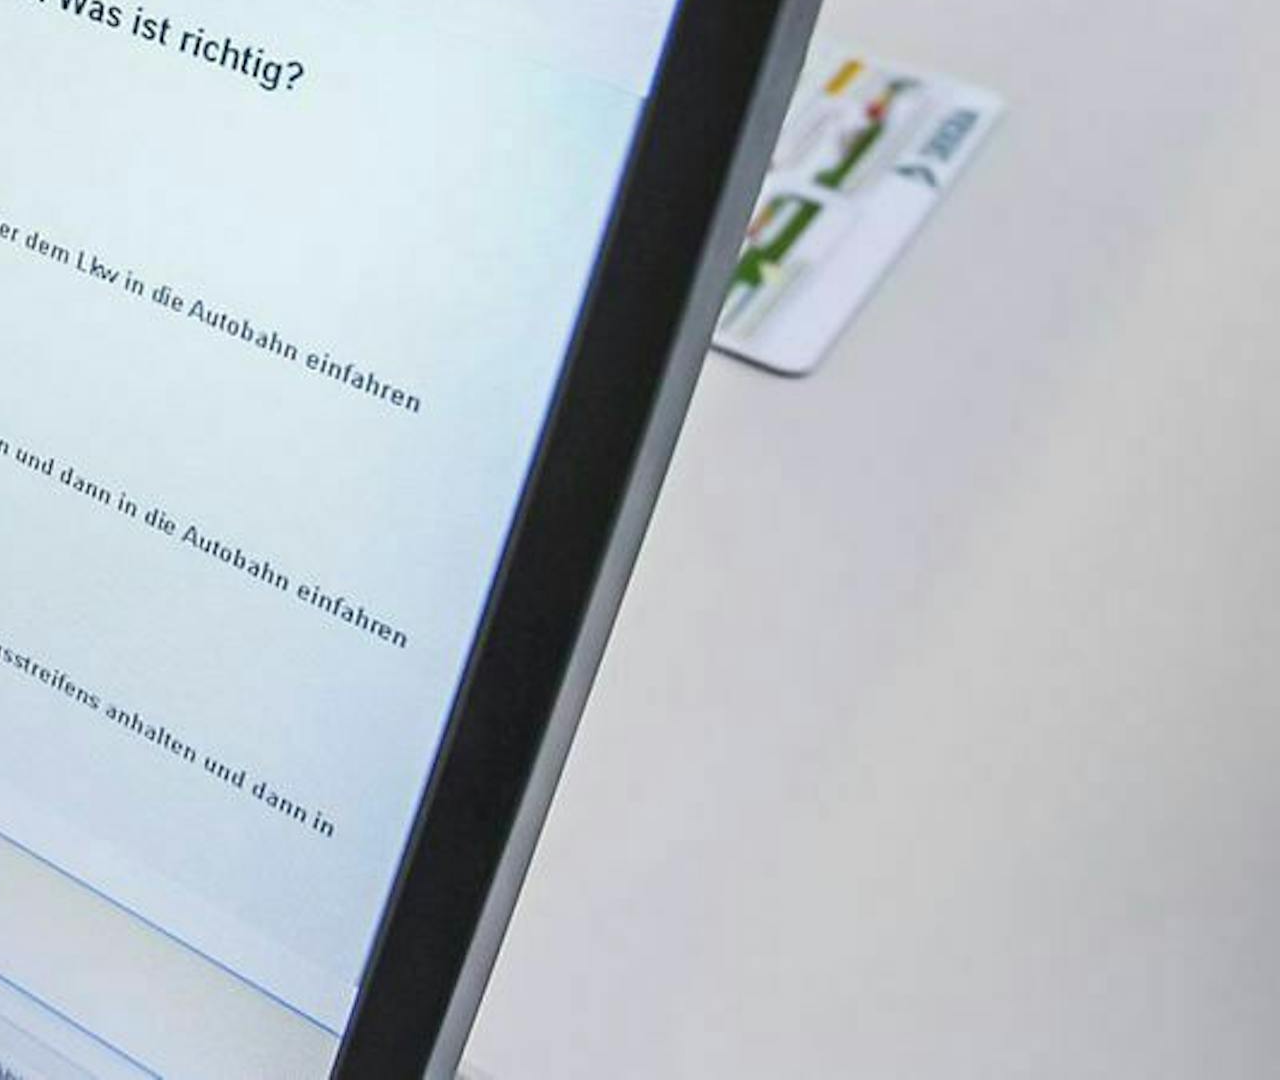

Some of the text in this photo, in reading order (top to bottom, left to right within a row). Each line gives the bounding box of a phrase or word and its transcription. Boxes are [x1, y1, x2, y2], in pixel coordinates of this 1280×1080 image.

[132, 6, 171, 46] ist
[179, 27, 306, 92] richtig?
[25, 233, 70, 264] dem
[76, 250, 120, 284] Lkw
[124, 270, 144, 297] in
[151, 285, 184, 312] die
[187, 299, 298, 360] Autobahn
[305, 352, 422, 413] einfahren
[15, 447, 54, 476] und
[60, 467, 113, 505] dann
[118, 491, 137, 518] in
[144, 508, 176, 536] die
[181, 525, 289, 591] Autobahn
[297, 584, 409, 649] einfahren
[106, 704, 197, 764] anhalten
[203, 755, 246, 788] und
[252, 780, 307, 823] dann
[313, 811, 336, 838] in
